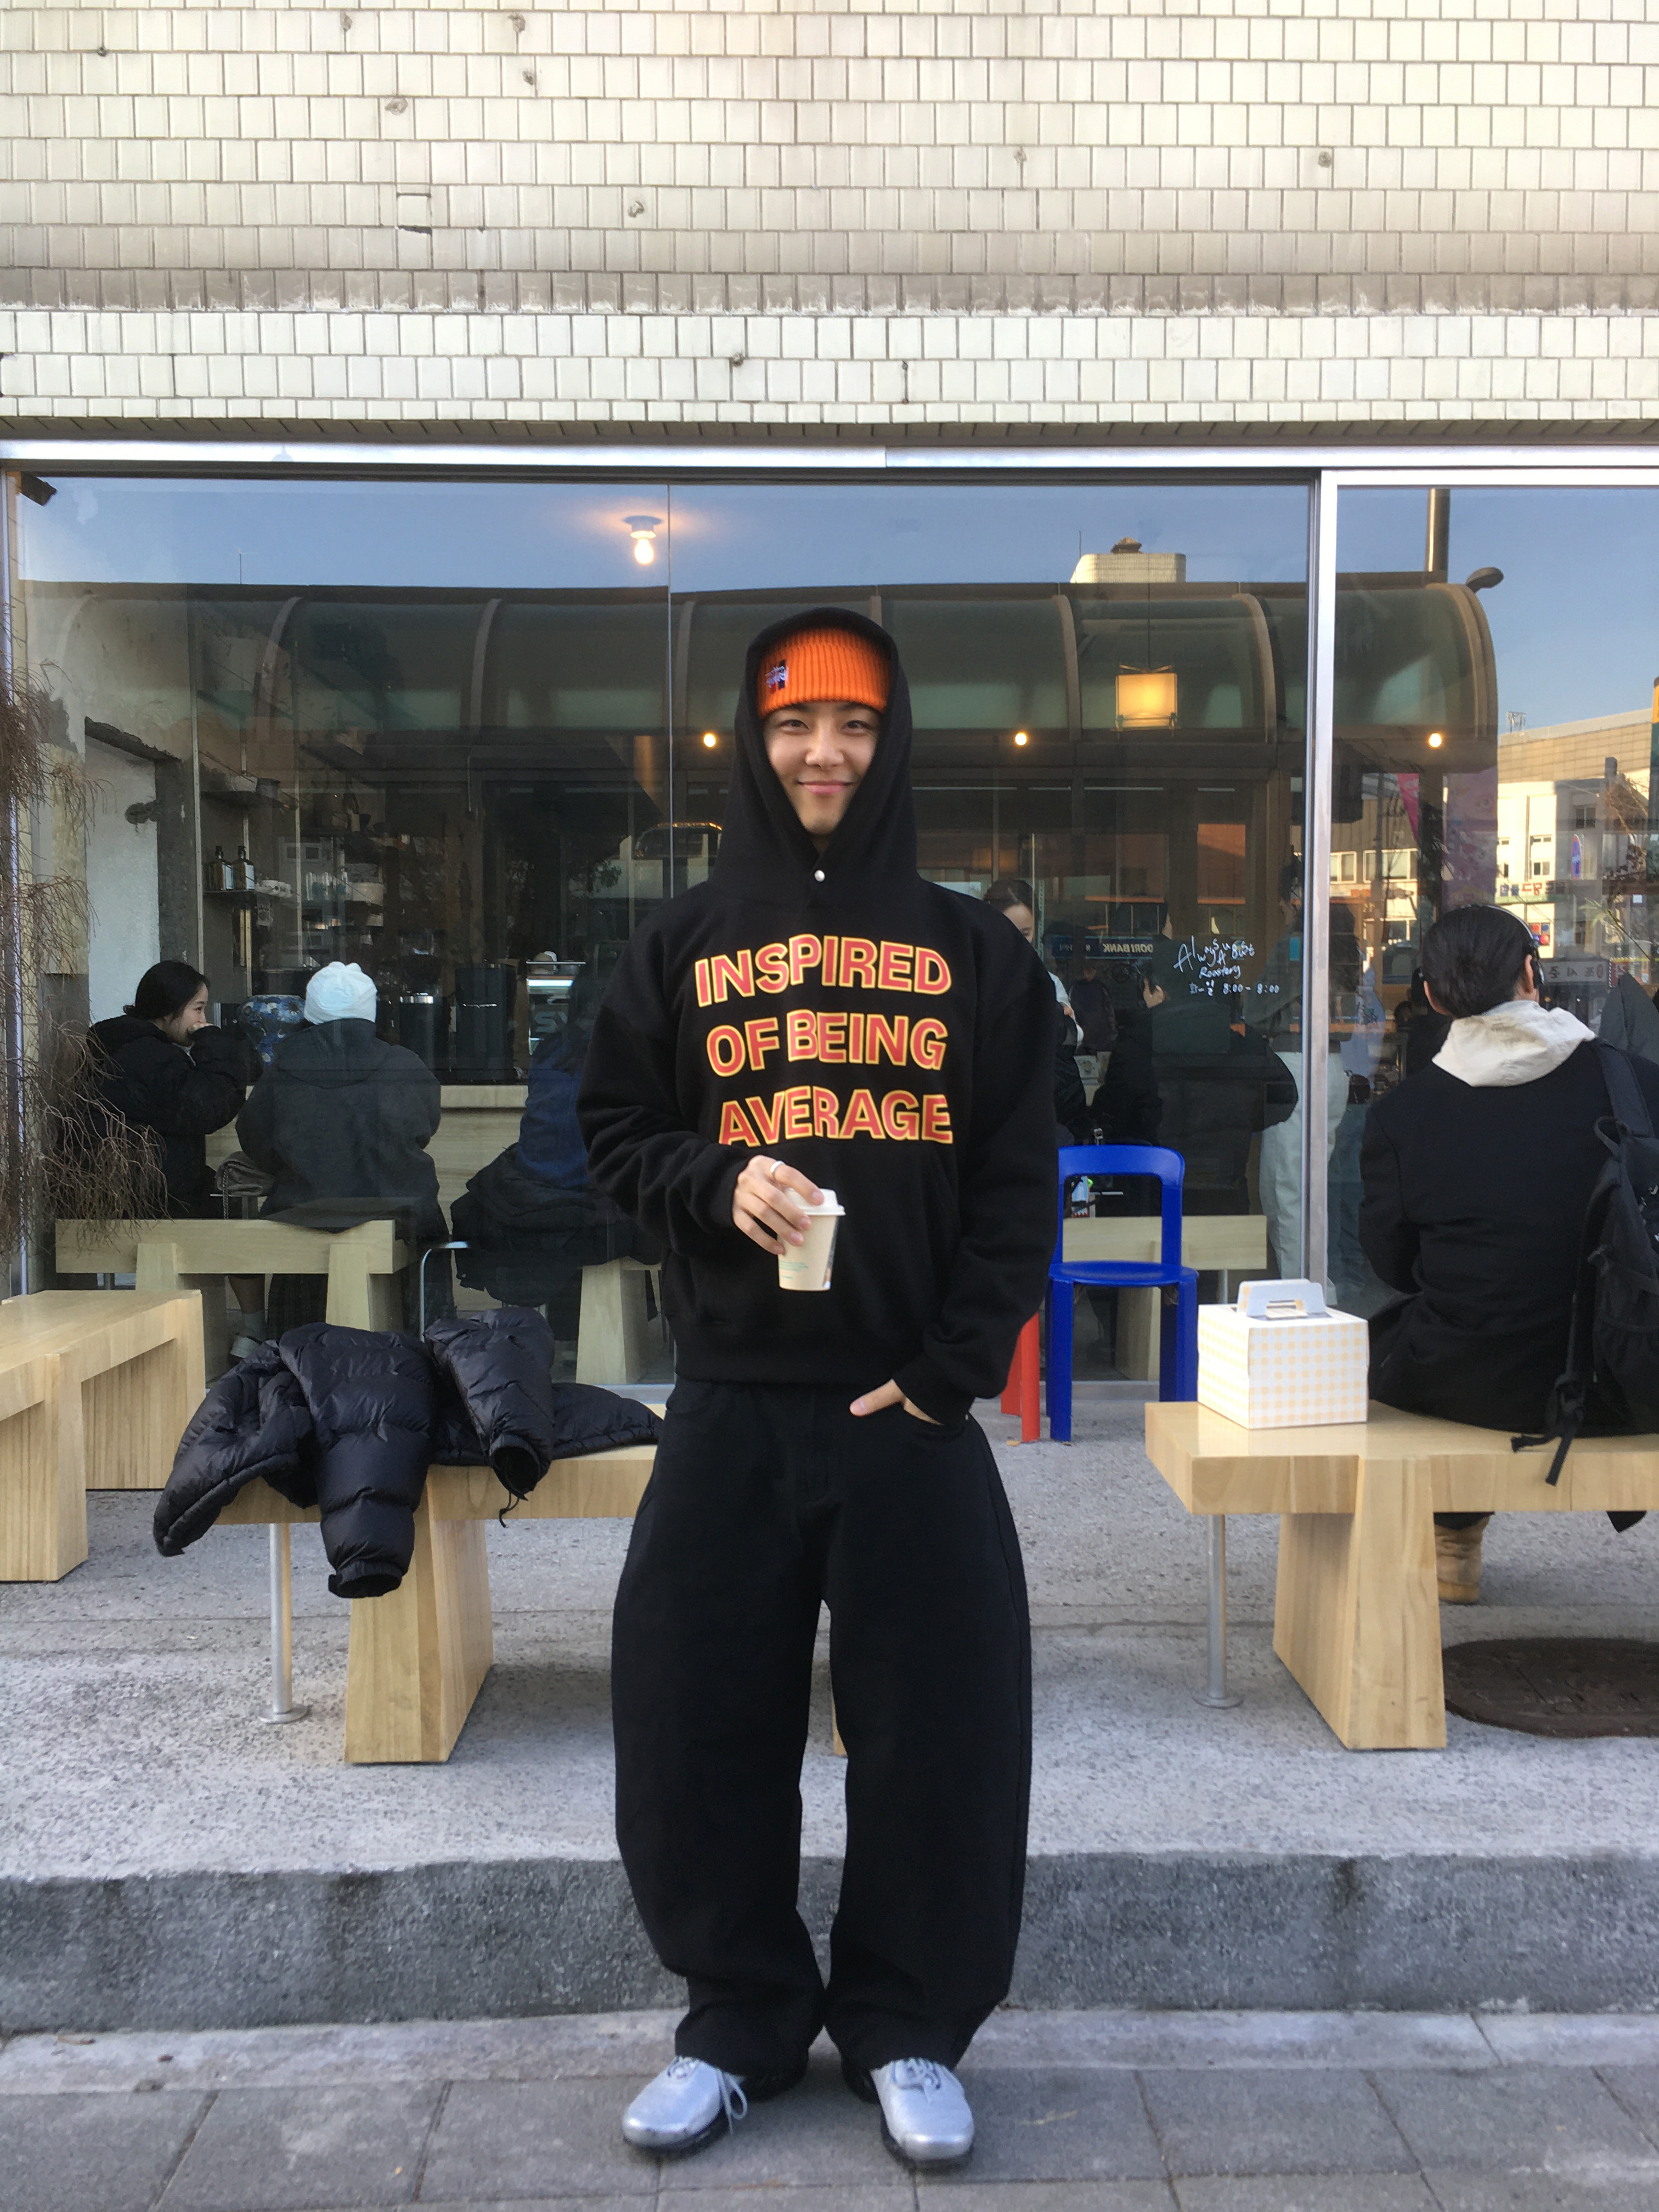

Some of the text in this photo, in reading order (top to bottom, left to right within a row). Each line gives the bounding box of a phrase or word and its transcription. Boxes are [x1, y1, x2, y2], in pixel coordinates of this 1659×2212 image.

[694, 933, 952, 1008] INSPIRED
[1173, 935, 1220, 973] Always
[1257, 983, 1279, 995] 8:00
[706, 1009, 949, 1077] OF BEING
[718, 1085, 953, 1148] AVERAGE
